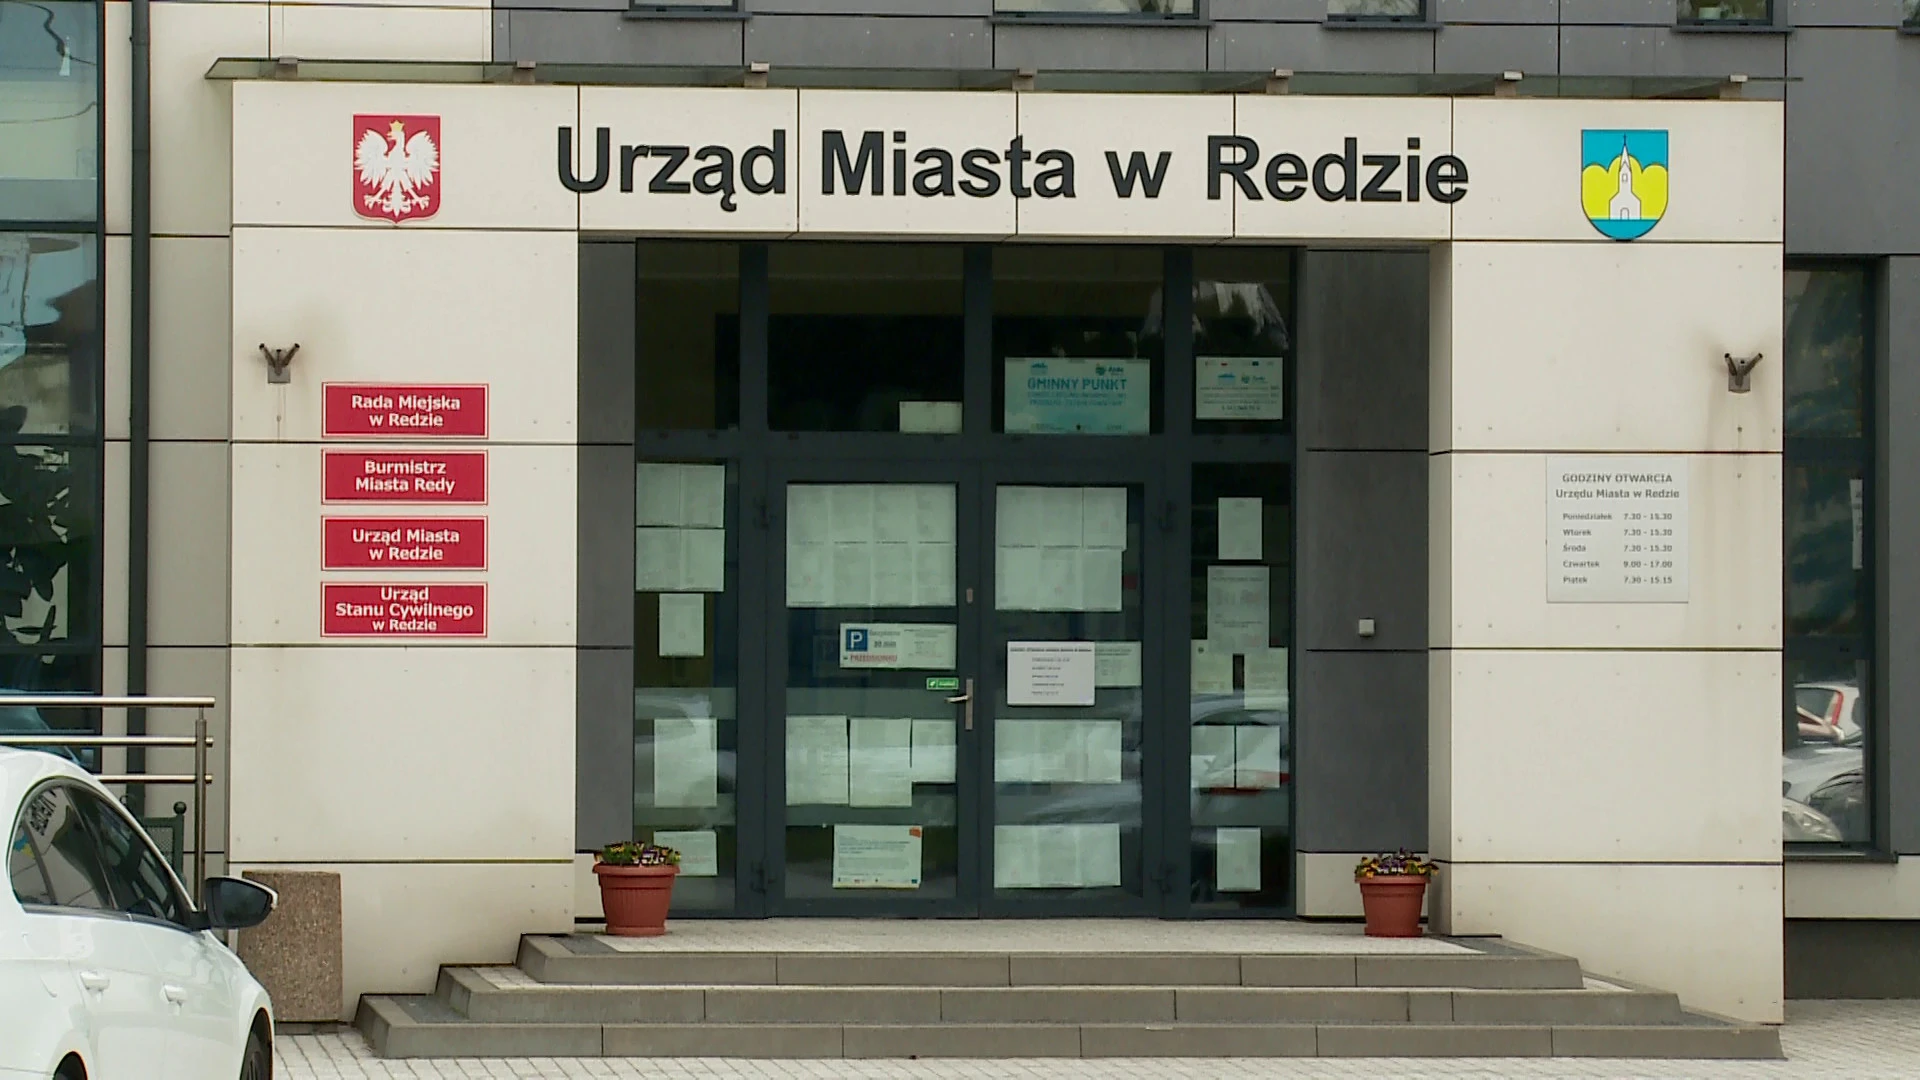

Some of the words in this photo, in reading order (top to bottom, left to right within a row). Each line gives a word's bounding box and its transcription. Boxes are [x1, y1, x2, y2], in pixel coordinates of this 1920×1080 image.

[558, 126, 787, 212] Urząd
[821, 129, 1076, 198] Miasta
[1104, 151, 1172, 199] w
[1207, 135, 1469, 204] Redzie
[1027, 377, 1079, 390] GMINNY
[1082, 378, 1128, 391] PUNKT
[351, 395, 393, 409] Rada
[398, 395, 461, 411] Miejska
[369, 415, 384, 426] w
[388, 412, 443, 426] Redzie
[364, 460, 446, 475] Burmistrz
[355, 477, 409, 491] Miasta
[414, 478, 455, 494] Redy
[1562, 473, 1612, 483] GODZINY
[1615, 473, 1673, 483] OTWARCIA
[1555, 488, 1593, 500] Urzędu
[1596, 488, 1630, 498] Miasta
[1645, 488, 1680, 498] Redzie
[352, 528, 401, 545] Urząd
[406, 528, 460, 542] Miasta
[369, 548, 384, 560] w
[388, 546, 443, 560] Redzie
[380, 586, 429, 603] Urząd
[335, 602, 384, 616] Stanu
[389, 602, 474, 620] Cywilnego
[371, 620, 385, 631] w
[389, 618, 437, 632] Redzie
